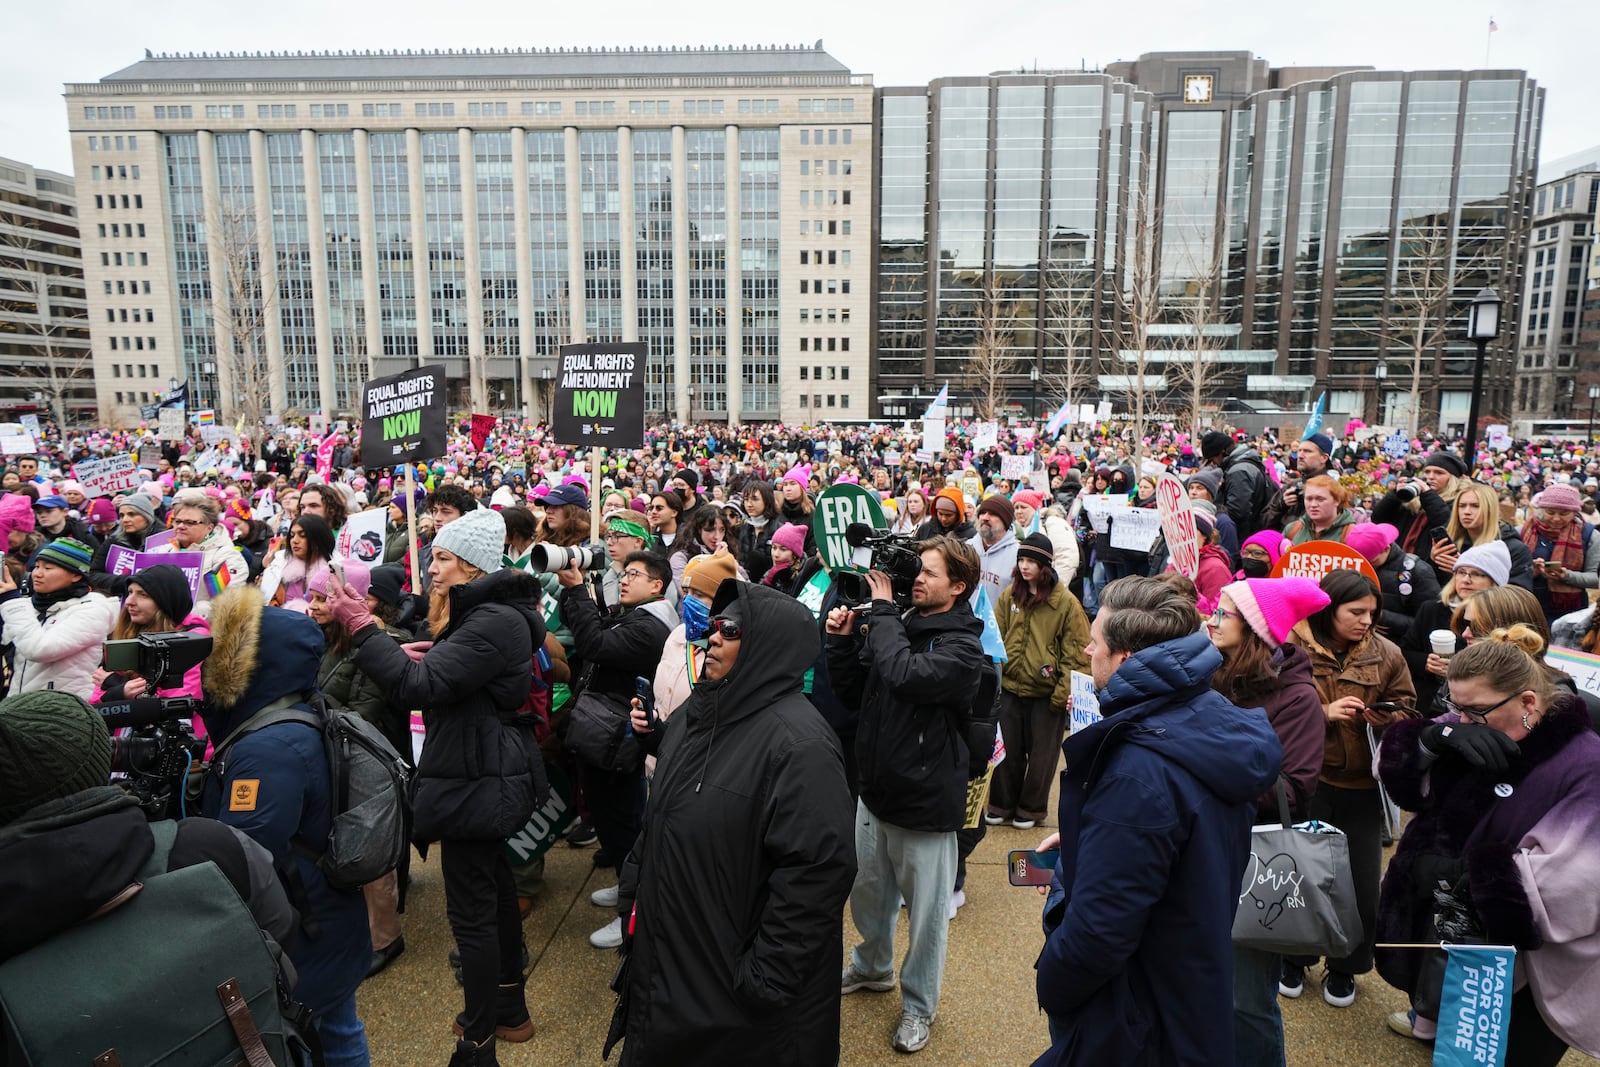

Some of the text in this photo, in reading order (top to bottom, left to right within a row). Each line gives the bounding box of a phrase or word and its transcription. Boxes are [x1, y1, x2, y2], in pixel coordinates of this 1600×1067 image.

[563, 354, 635, 373] EQUAL RIGHTS
[367, 375, 434, 404] EQUAL RIGHTS
[561, 372, 633, 388] AMENDMENT
[369, 391, 434, 419] AMENDMENT
[573, 390, 618, 418] NOW
[382, 409, 421, 441] NOW
[820, 494, 874, 535] ERA
[826, 533, 853, 569] NO
[1289, 552, 1364, 572] RESPECT
[1282, 568, 1328, 583] WOM
[97, 704, 131, 716] RØD
[1286, 896, 1306, 909] RN
[1455, 965, 1480, 1053] FUTURE
[1473, 965, 1495, 1064] FOR OUR
[1486, 955, 1509, 1067] MARCHIN
